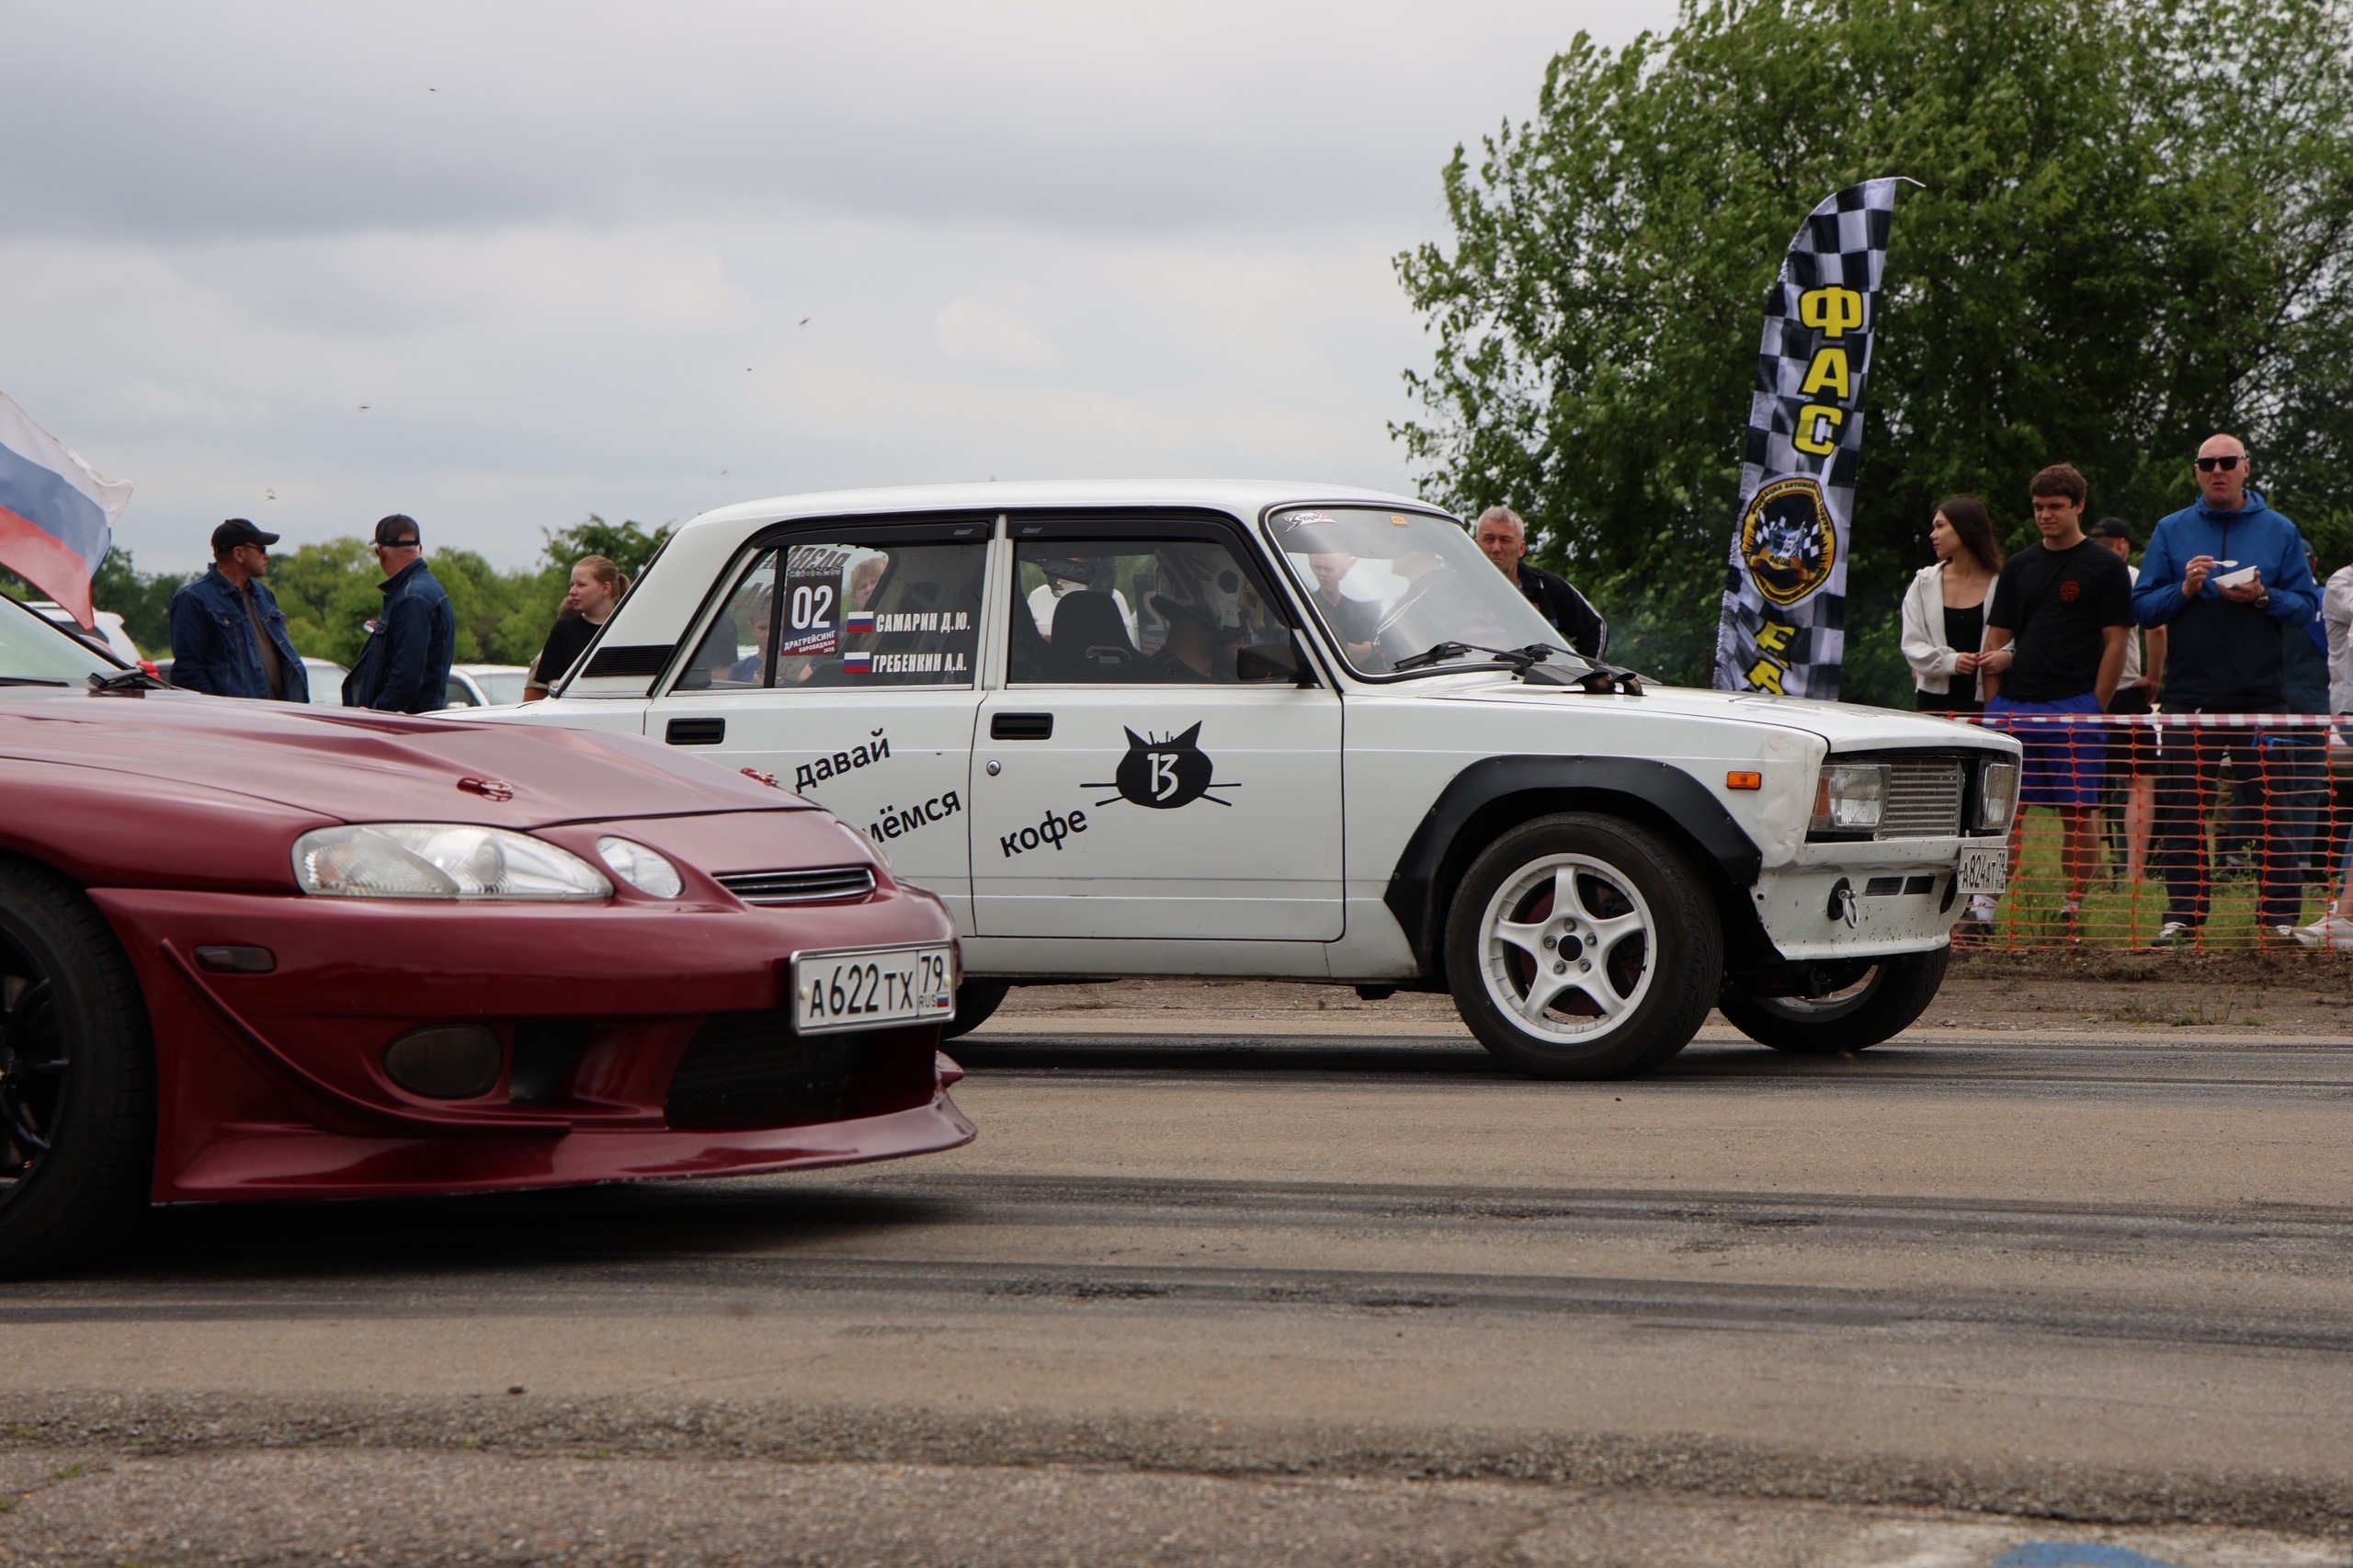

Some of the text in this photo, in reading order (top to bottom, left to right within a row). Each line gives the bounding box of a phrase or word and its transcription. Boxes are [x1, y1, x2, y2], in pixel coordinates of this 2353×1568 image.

[1794, 286, 1864, 456] ФАС
[791, 585, 834, 630] 02
[876, 611, 971, 633] САМАРИН Д.Ю.
[784, 630, 835, 652] ДРАГРЕЙСИНГ
[799, 639, 835, 653] БИРОБИДЖАН
[872, 653, 968, 673] ГРЕБЕНКИН А.А.
[795, 727, 891, 794] давай
[1147, 753, 1178, 801] 13
[1000, 809, 1088, 858] кофе
[810, 954, 944, 1018] А622ТХ 79
[919, 994, 936, 1008] RUS
